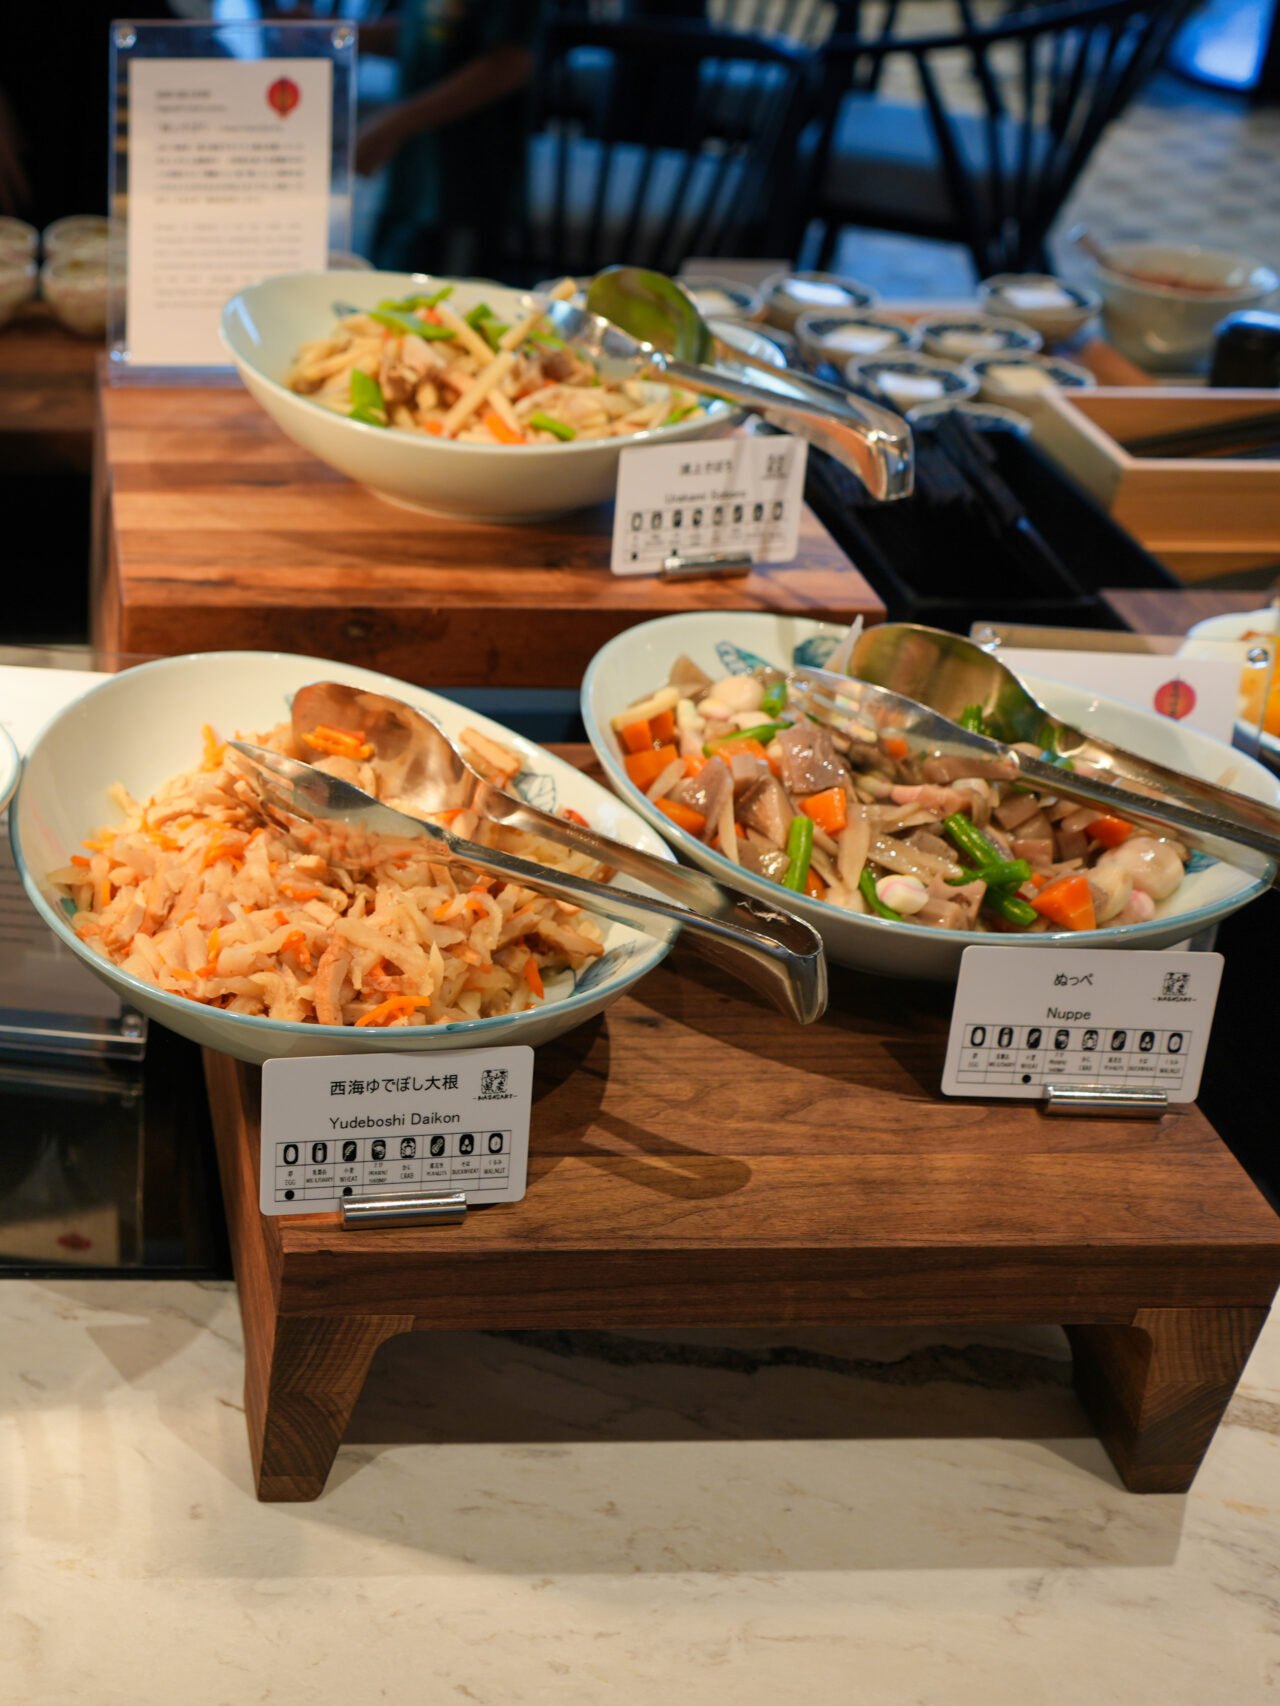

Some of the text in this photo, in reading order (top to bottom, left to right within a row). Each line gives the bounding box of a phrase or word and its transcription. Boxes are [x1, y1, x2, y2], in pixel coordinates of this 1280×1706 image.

[1054, 973, 1094, 987] ぬっぺ
[1046, 1007, 1092, 1021] Nuppe
[330, 1074, 459, 1096] 西海ゆでぼし大根
[329, 1111, 461, 1130] Yudeboshi Daikon
